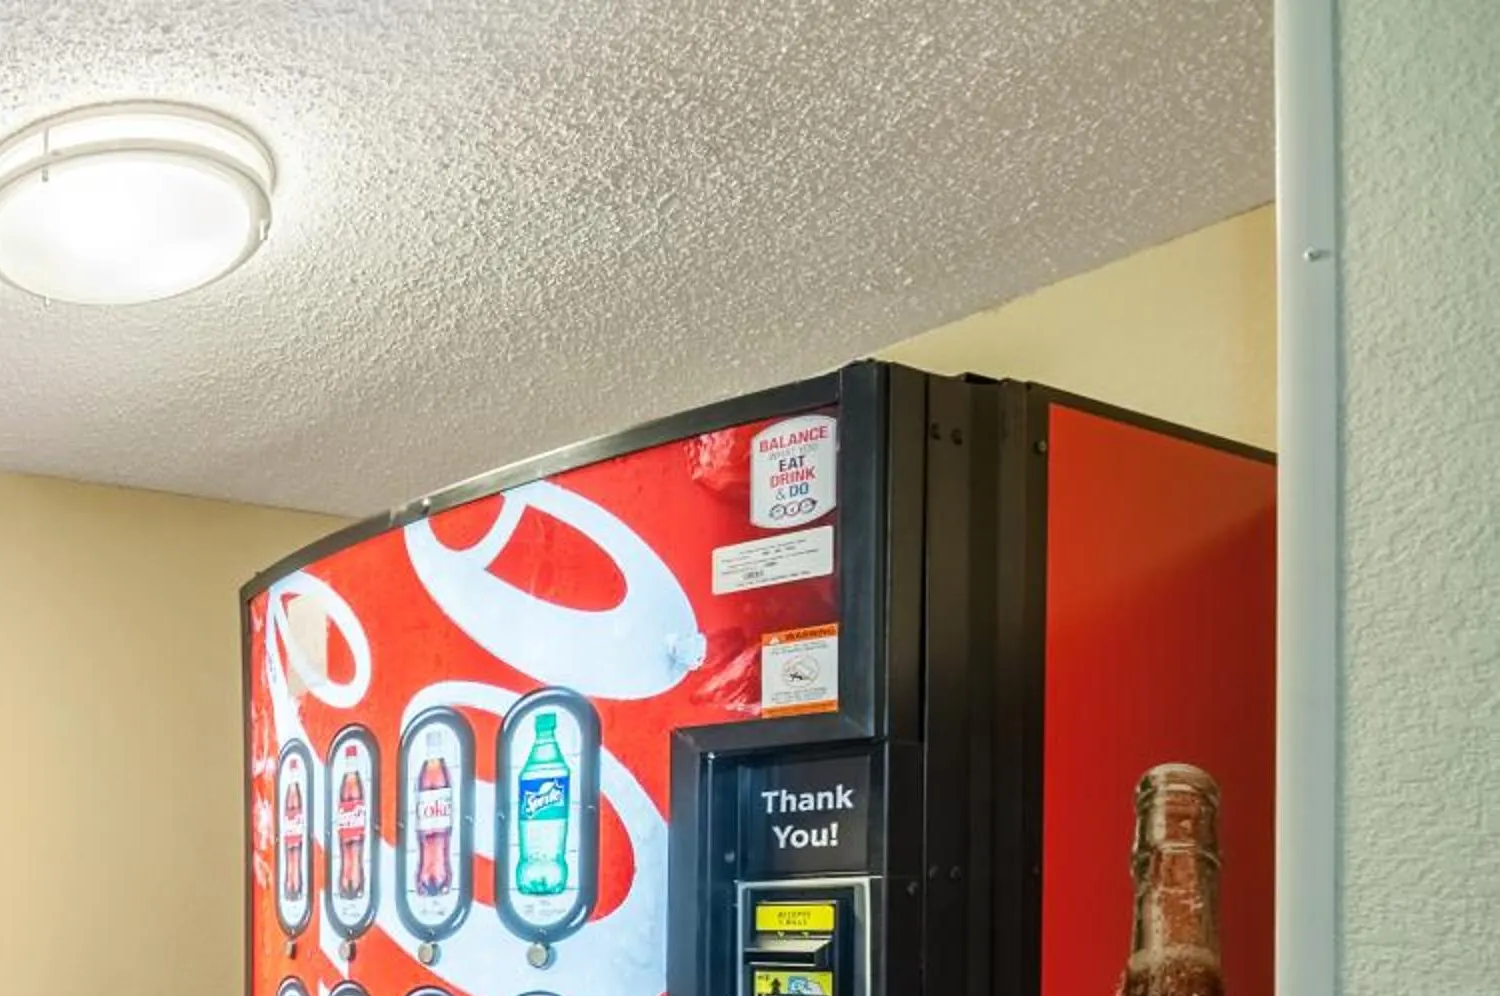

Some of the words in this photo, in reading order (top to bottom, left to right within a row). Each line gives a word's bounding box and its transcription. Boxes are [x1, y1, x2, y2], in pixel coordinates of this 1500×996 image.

[759, 425, 829, 453] BALANCE
[779, 455, 805, 472] EAT
[770, 466, 816, 488] DRINK
[789, 481, 809, 498] DO
[761, 784, 854, 814] Thank
[772, 821, 838, 849] You!
